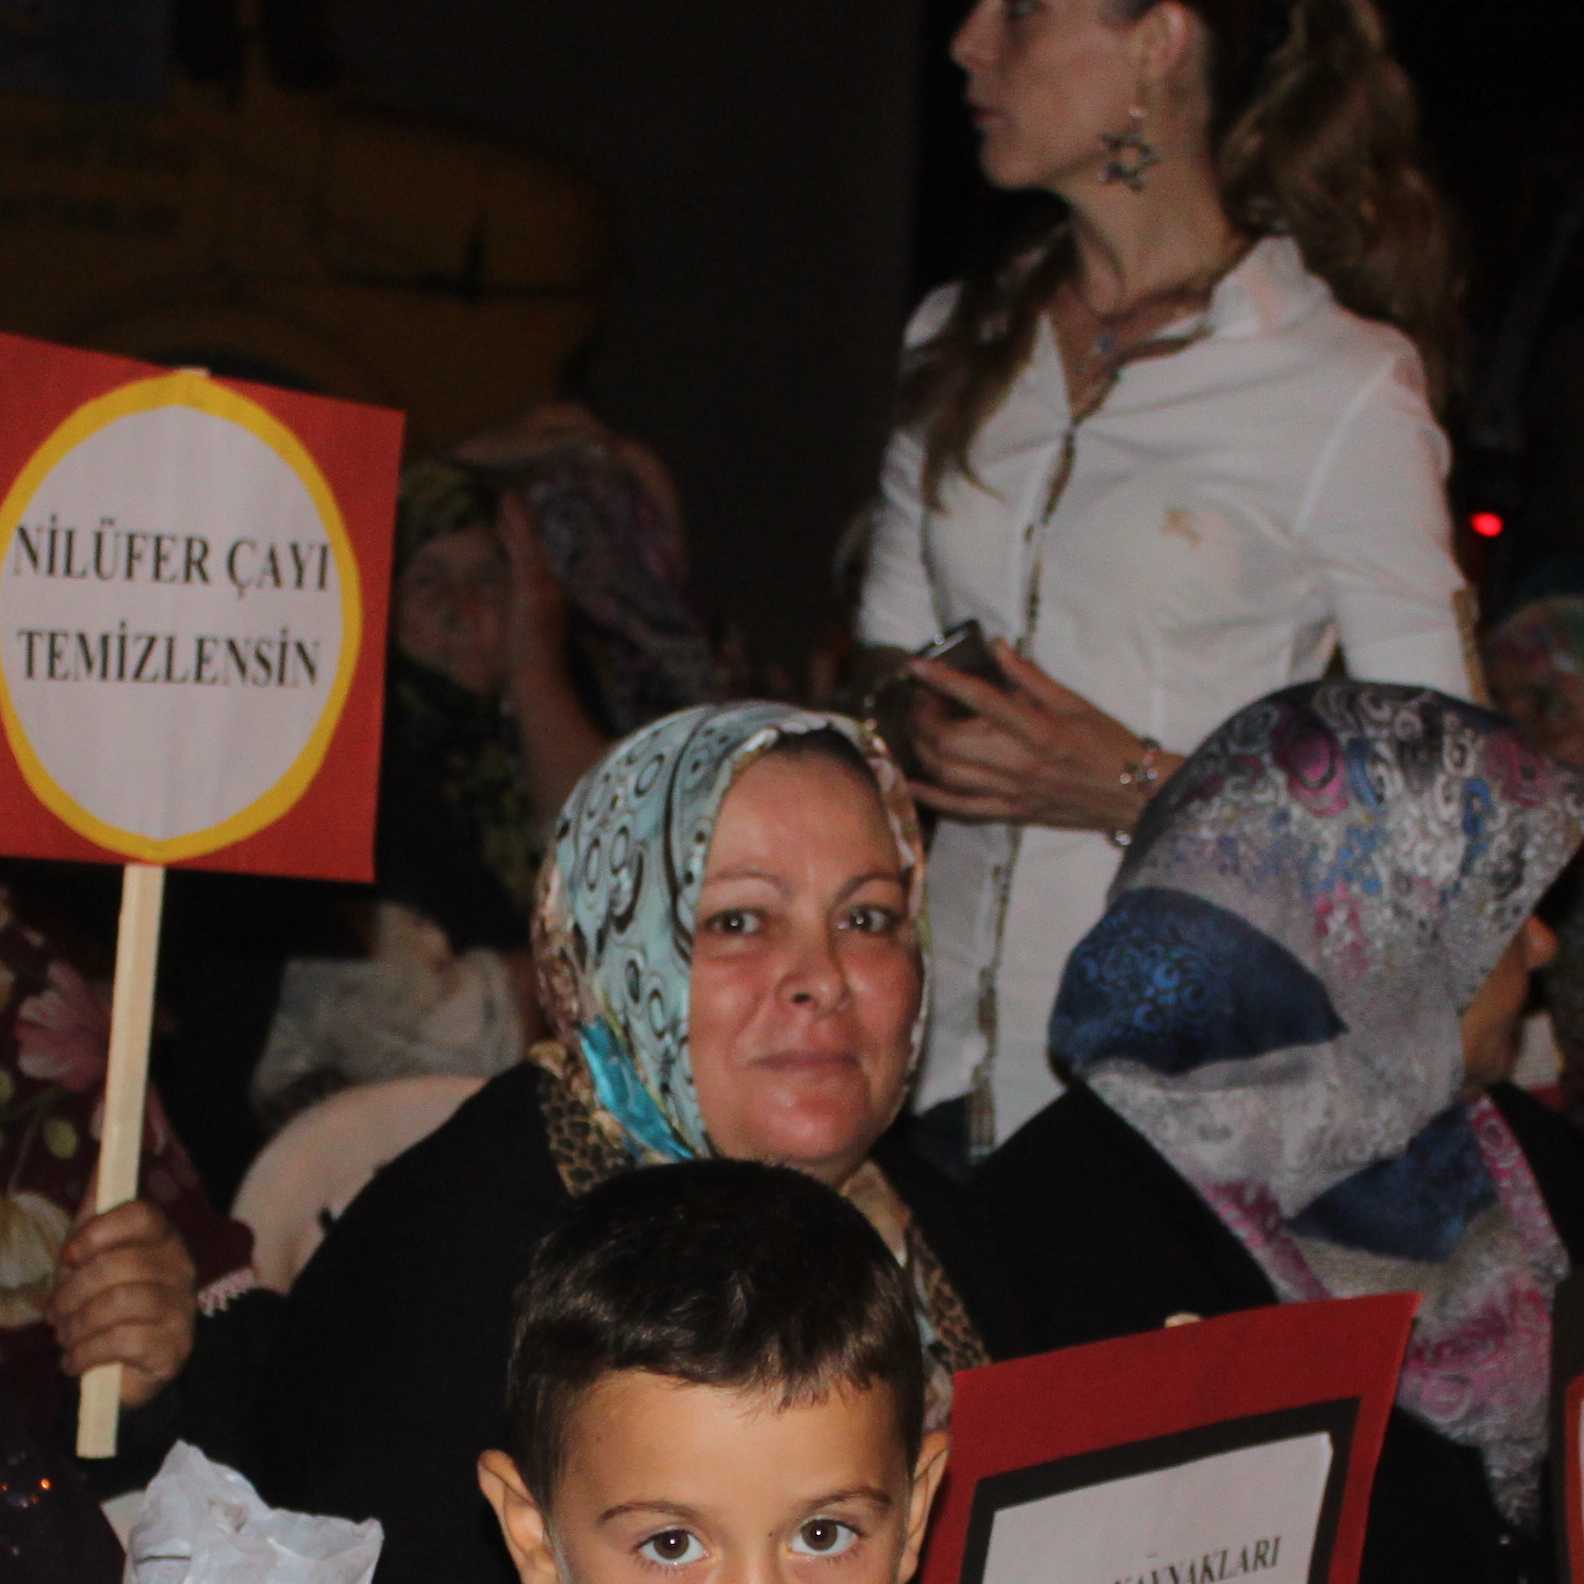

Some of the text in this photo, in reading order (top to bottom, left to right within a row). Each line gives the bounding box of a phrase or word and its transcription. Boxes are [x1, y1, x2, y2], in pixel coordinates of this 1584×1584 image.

[13, 513, 330, 599] NİLÜFER ÇAYI
[18, 620, 321, 688] TEMİZLENSİN
